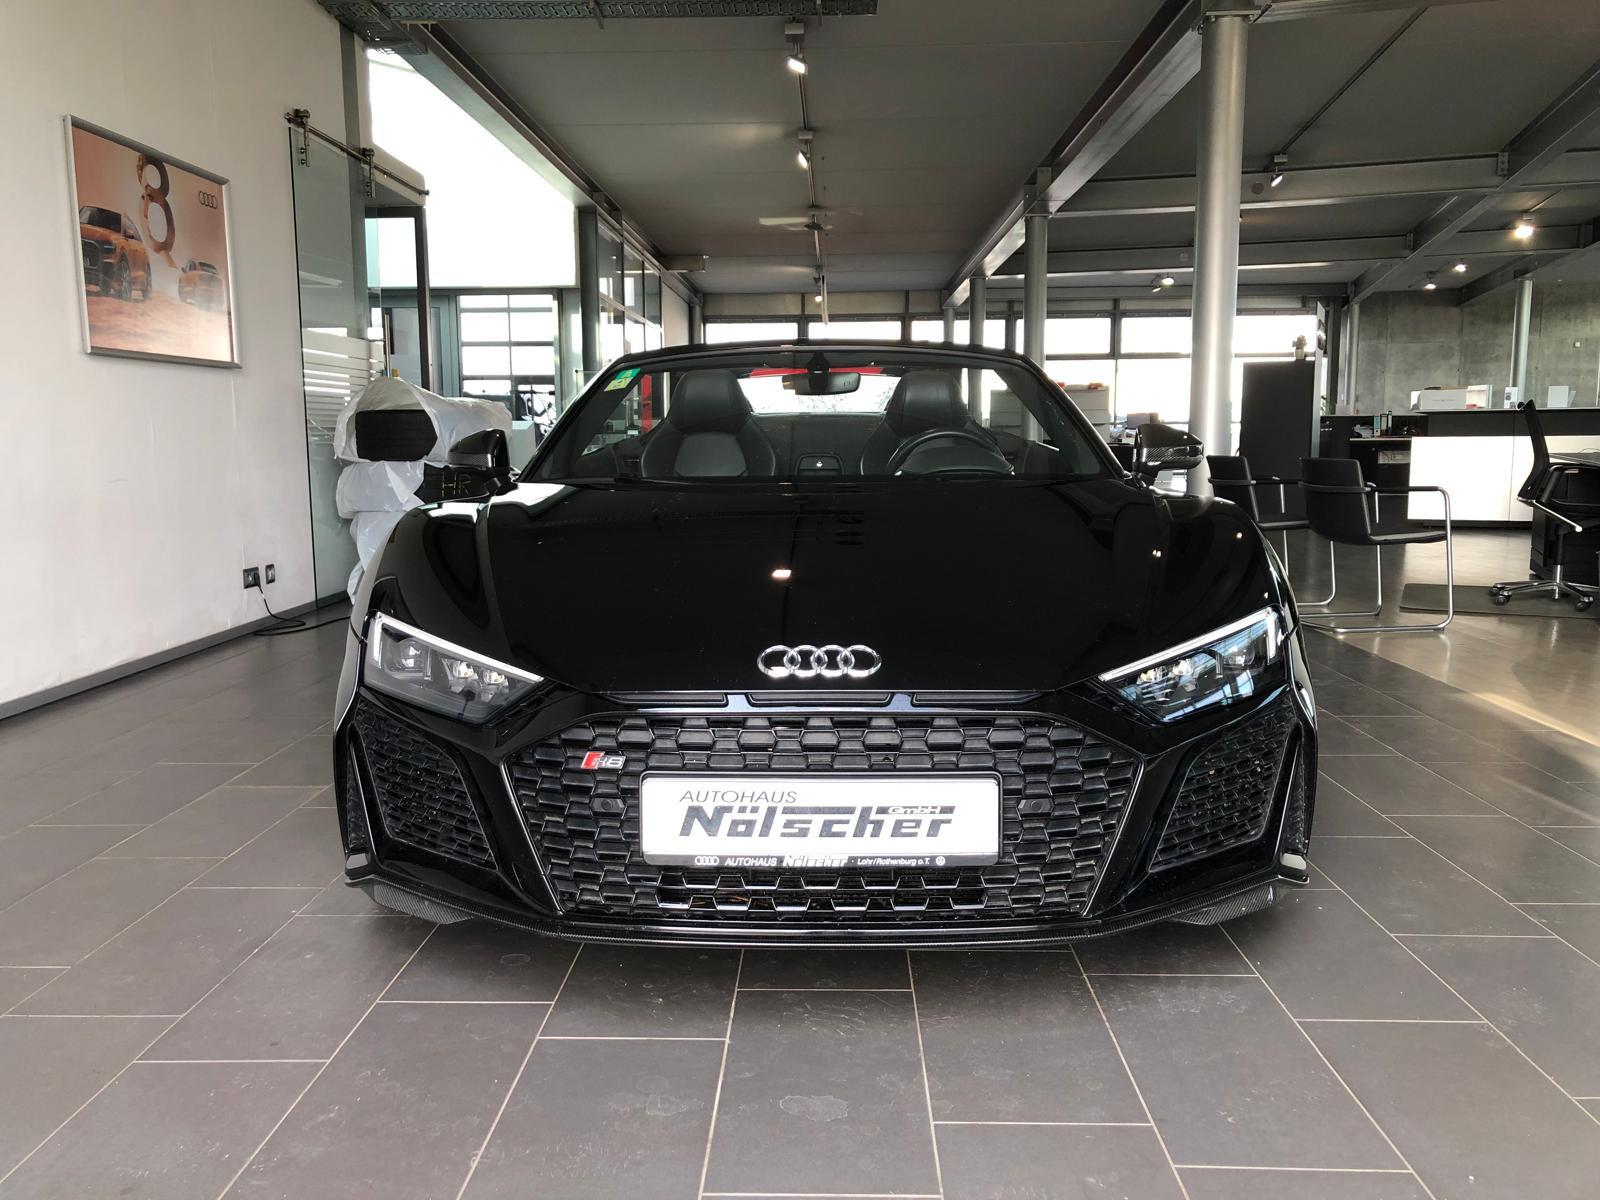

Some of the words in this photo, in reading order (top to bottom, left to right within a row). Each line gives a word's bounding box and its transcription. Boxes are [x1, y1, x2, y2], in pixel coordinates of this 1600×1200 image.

[441, 471, 472, 498] HR
[679, 790, 798, 803] AUTOHAUS
[888, 806, 941, 815] GmbH
[679, 805, 954, 838] Nölscher
[724, 857, 778, 867] AUTOHAUS
